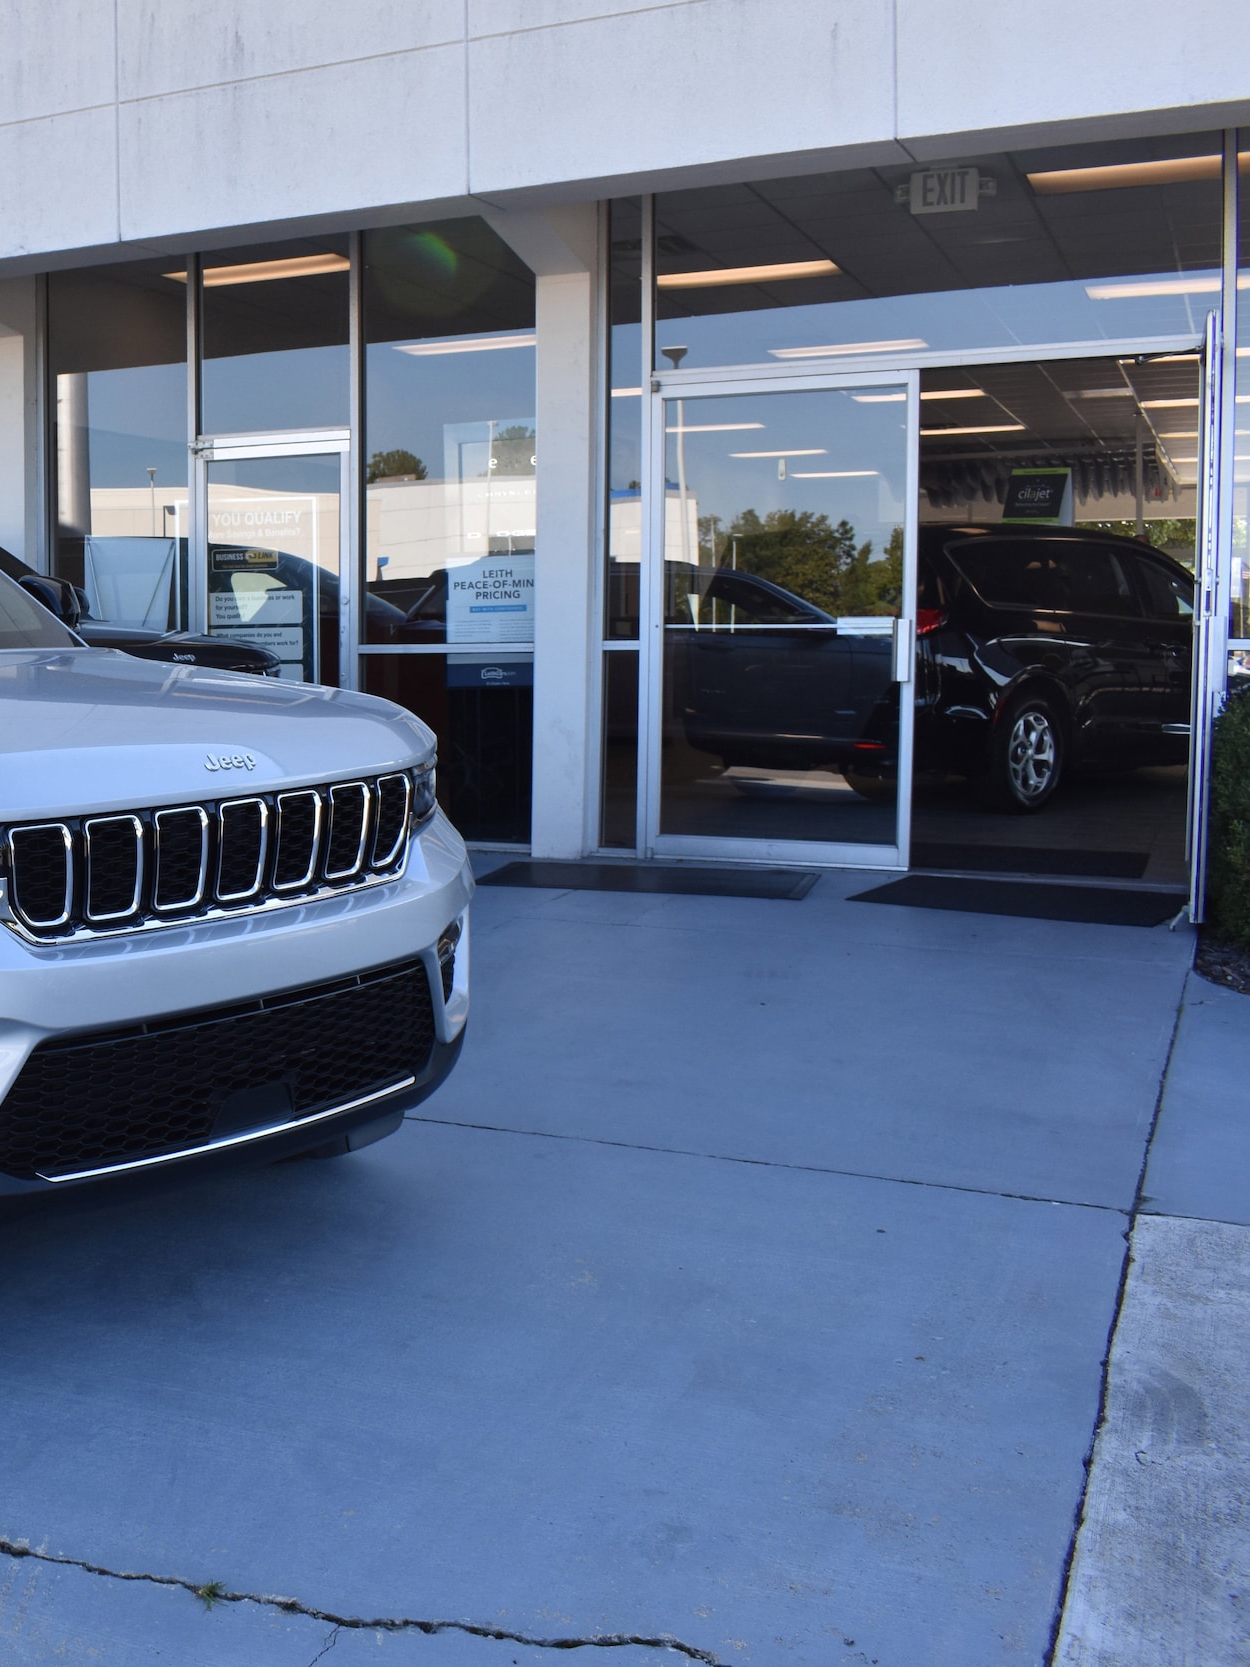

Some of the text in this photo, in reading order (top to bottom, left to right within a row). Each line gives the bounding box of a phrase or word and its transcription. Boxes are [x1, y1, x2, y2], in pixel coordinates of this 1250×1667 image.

[922, 170, 969, 207] EXIT
[1017, 487, 1051, 502] cilajet
[211, 510, 301, 527] YOU QUALIFY
[215, 552, 244, 561] BUSINESS
[482, 569, 513, 579] LEITH
[453, 579, 535, 590] PEACE-OF-MIN
[475, 590, 521, 600] PRICING
[172, 653, 196, 662] Jeep
[204, 753, 258, 772] Jeep
